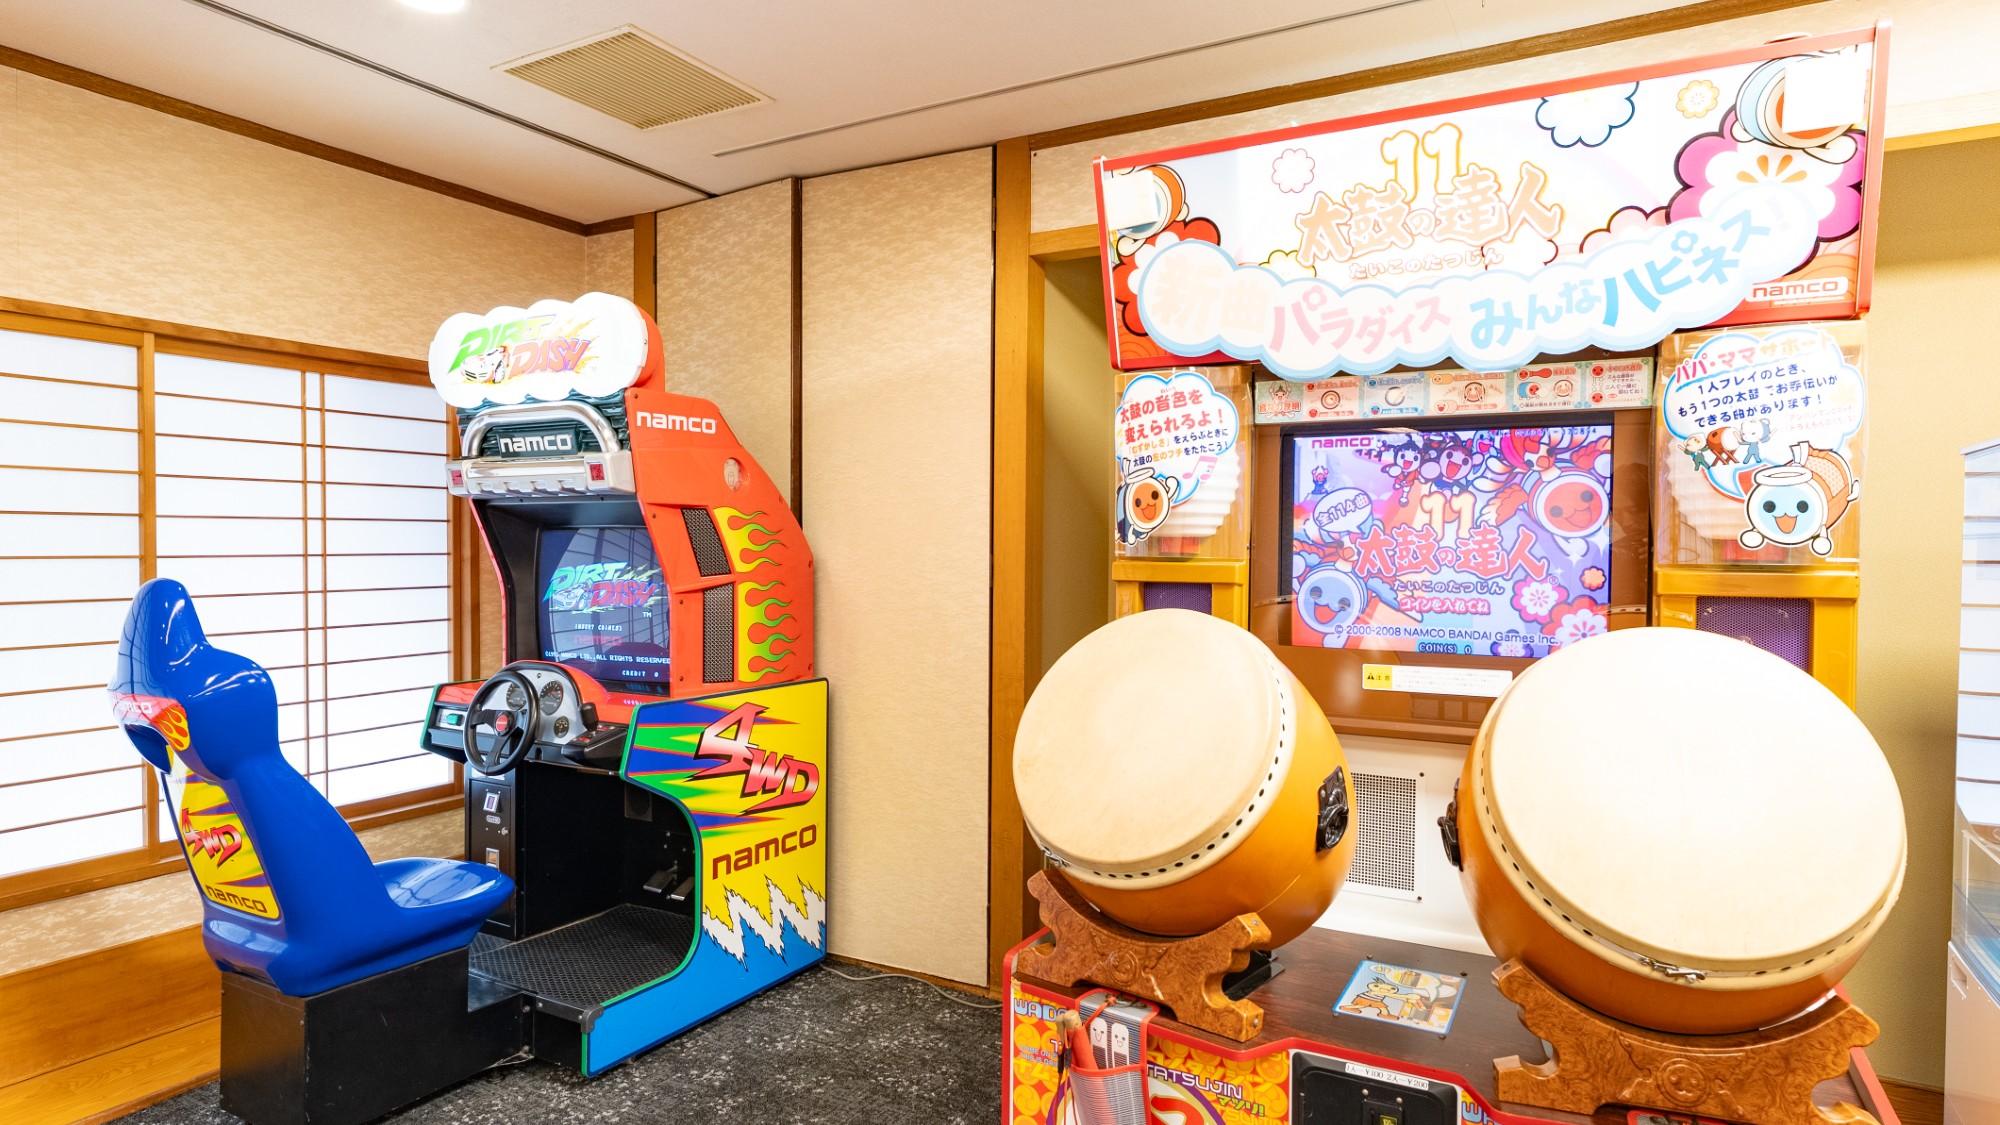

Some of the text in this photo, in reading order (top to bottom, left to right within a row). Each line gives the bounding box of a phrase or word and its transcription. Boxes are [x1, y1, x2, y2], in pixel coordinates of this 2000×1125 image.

[1296, 162, 1562, 267] 太鼓の達人
[1349, 250, 1505, 280] たいこのたつじん
[1150, 253, 1452, 353] 新曲パラダイス
[1752, 279, 1839, 299] namco
[448, 313, 557, 374] DIRT
[508, 335, 592, 378] DASH
[1120, 388, 1203, 425] 太鼓の音色を
[636, 411, 717, 434] namco
[499, 432, 572, 453] namco
[1311, 436, 1372, 449] namco
[1355, 523, 1549, 582] 太鼓の達人
[542, 561, 628, 601] DIRT
[588, 578, 660, 608] DASH
[1393, 579, 1506, 596] たいこのたつじん
[1400, 597, 1491, 615] コインを入れてね
[1346, 625, 1401, 637] 2000-2008
[1403, 627, 1448, 639] NAMCO
[1448, 629, 1492, 641] BANDAI
[1494, 631, 1534, 644] Games
[1537, 633, 1559, 645] Inc.
[1418, 642, 1457, 654] COIN(S)
[609, 655, 634, 663] RIGHTS
[622, 669, 646, 677] CREDIT
[684, 701, 821, 818] 4WD
[180, 807, 243, 870] 4WD
[711, 823, 817, 880] namco
[205, 884, 268, 914] namco
[1147, 1064, 1242, 1099] TATSUJIN
